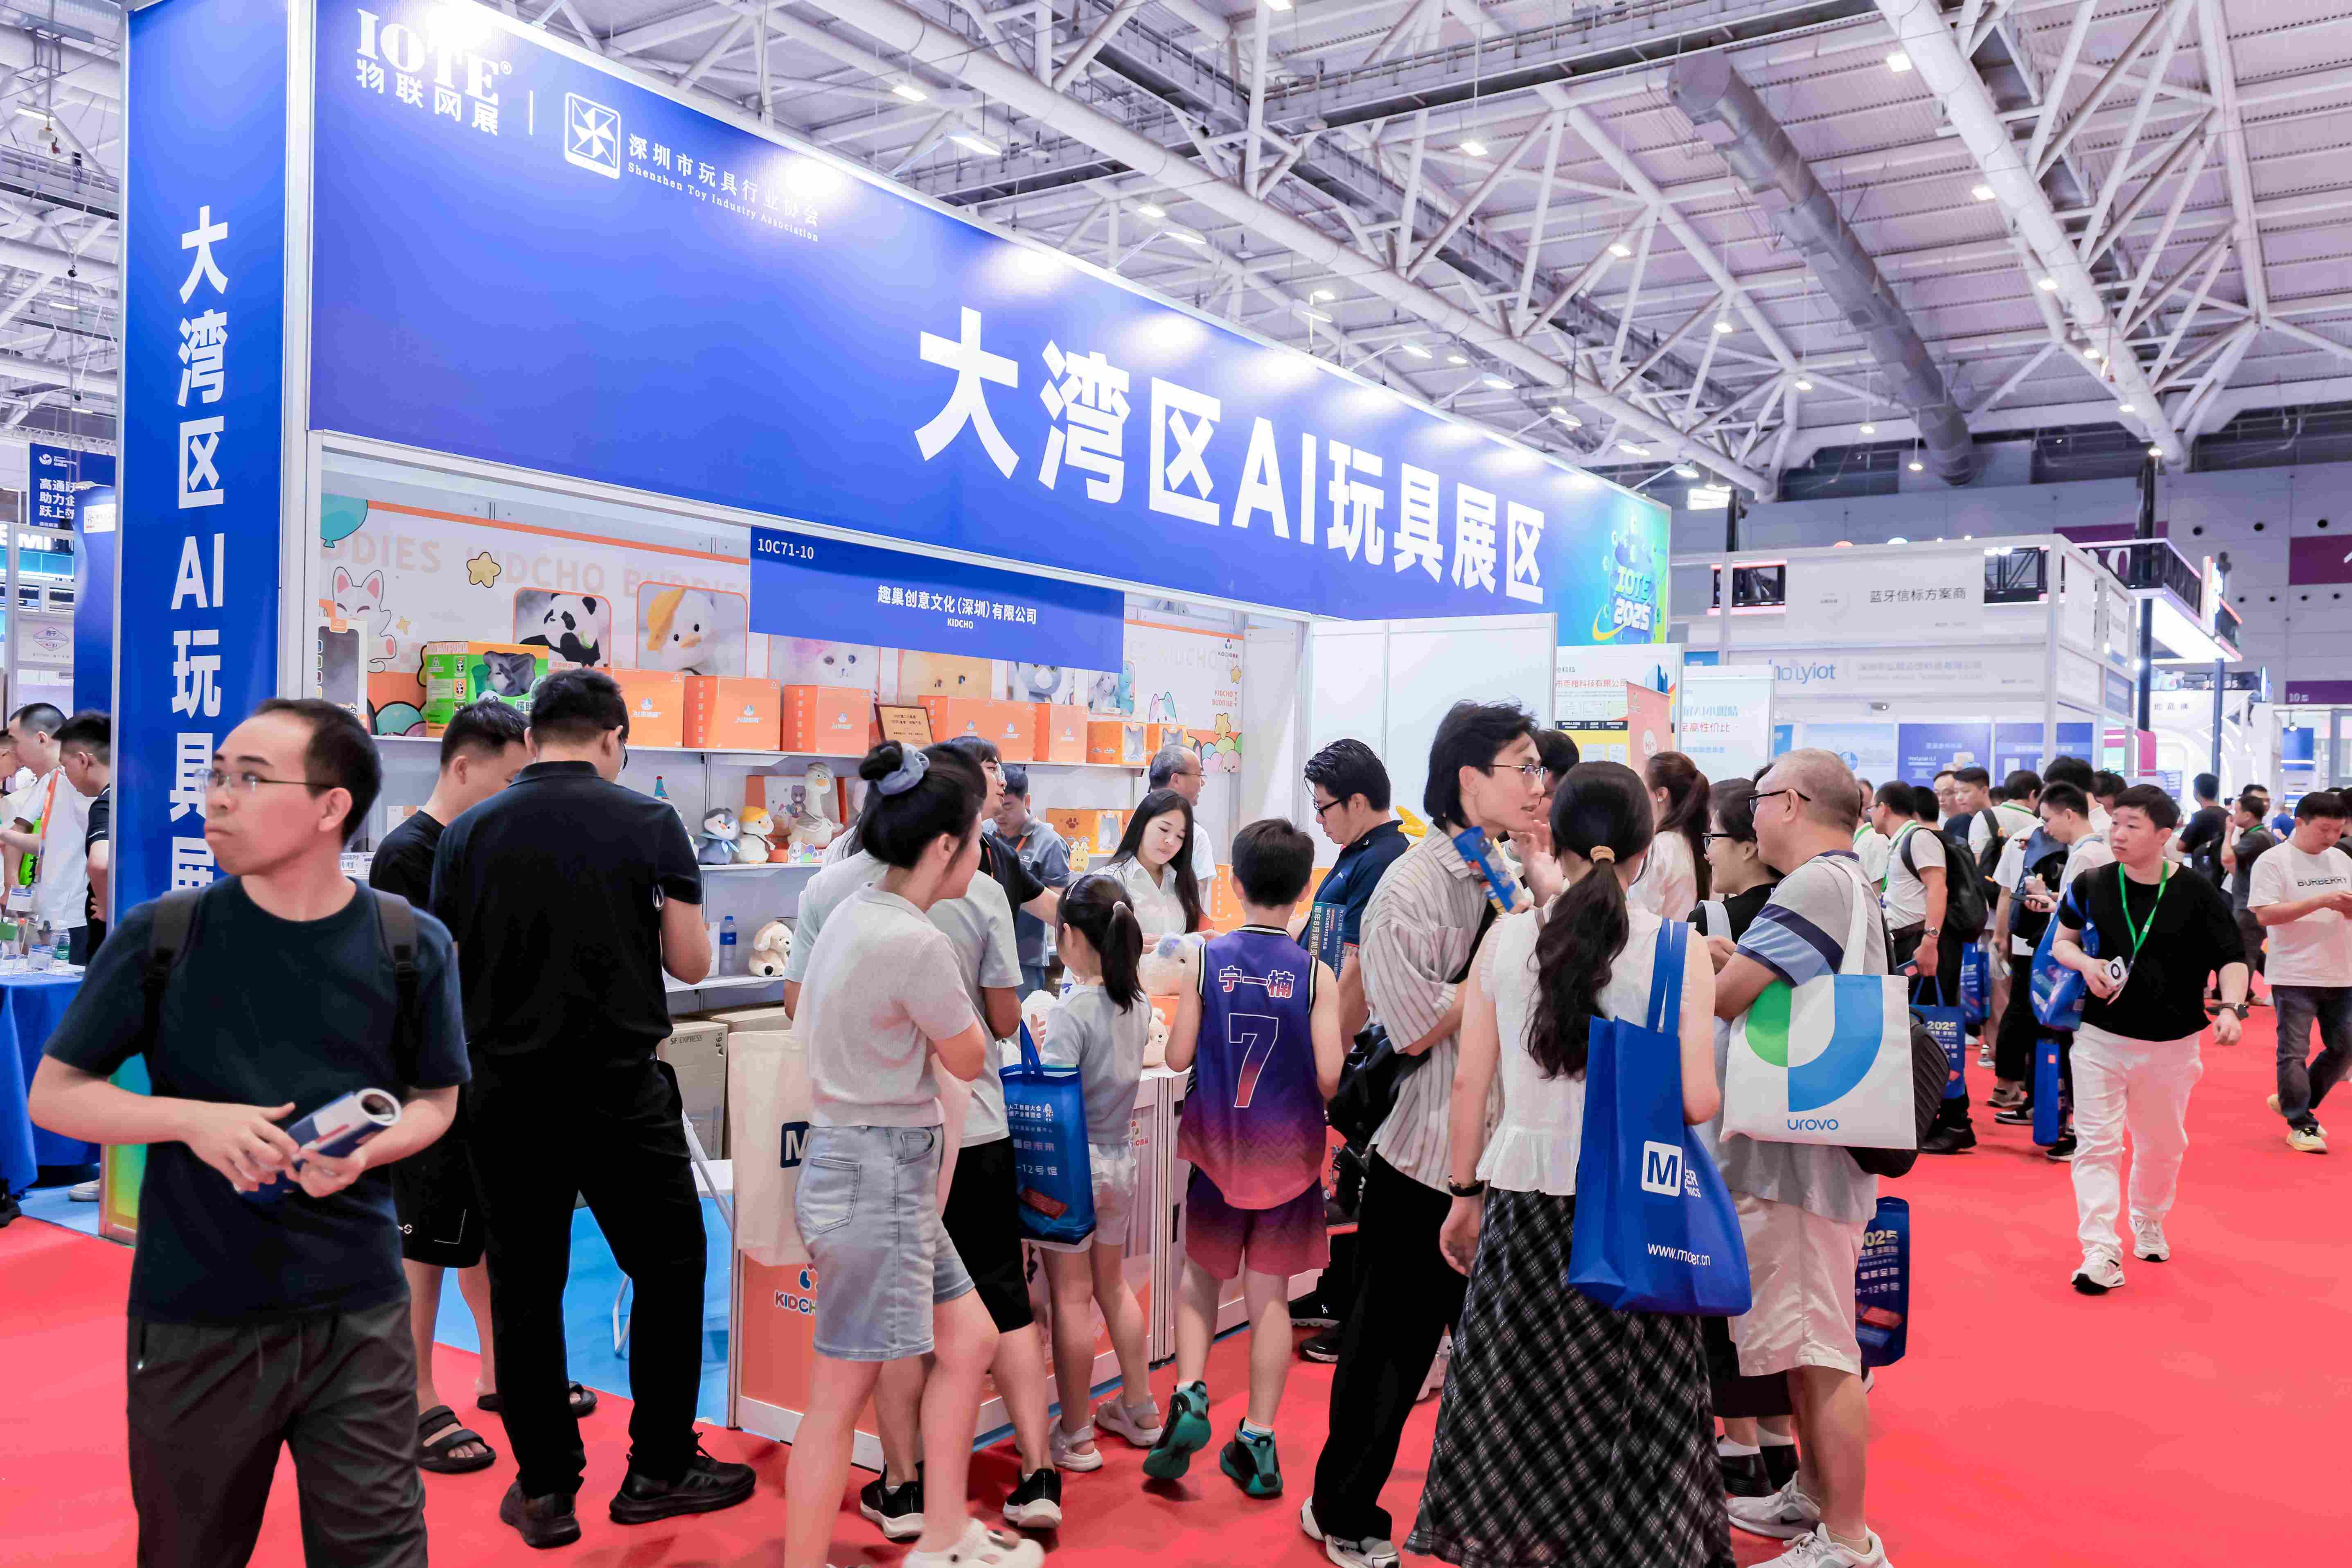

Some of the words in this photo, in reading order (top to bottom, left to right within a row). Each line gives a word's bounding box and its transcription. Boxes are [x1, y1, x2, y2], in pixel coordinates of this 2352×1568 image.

[356, 59, 498, 136] 物联网展
[629, 133, 819, 227] 深圳市玩具行业协会
[628, 161, 683, 191] Shenzhen
[688, 184, 707, 201] Toy
[711, 193, 756, 220] Industry
[760, 213, 819, 242] Association
[913, 306, 1546, 605] 大湾区AI玩具展区
[758, 538, 814, 560] 10C71-10
[878, 584, 1037, 625] 趣巢创意文化（深圳）有限公司
[1869, 587, 1967, 603] 蓝牙信标方案商
[947, 618, 974, 629] KIDCHO
[1614, 598, 1651, 632] 2025
[1219, 965, 1295, 999] 宁一楠
[679, 1034, 703, 1044] EXPRESS
[1927, 1021, 1957, 1030] 2025
[1229, 1013, 1279, 1108] 7
[1787, 1118, 1839, 1130] urovo
[1647, 1151, 1678, 1188] M
[1864, 1230, 1899, 1247] 025
